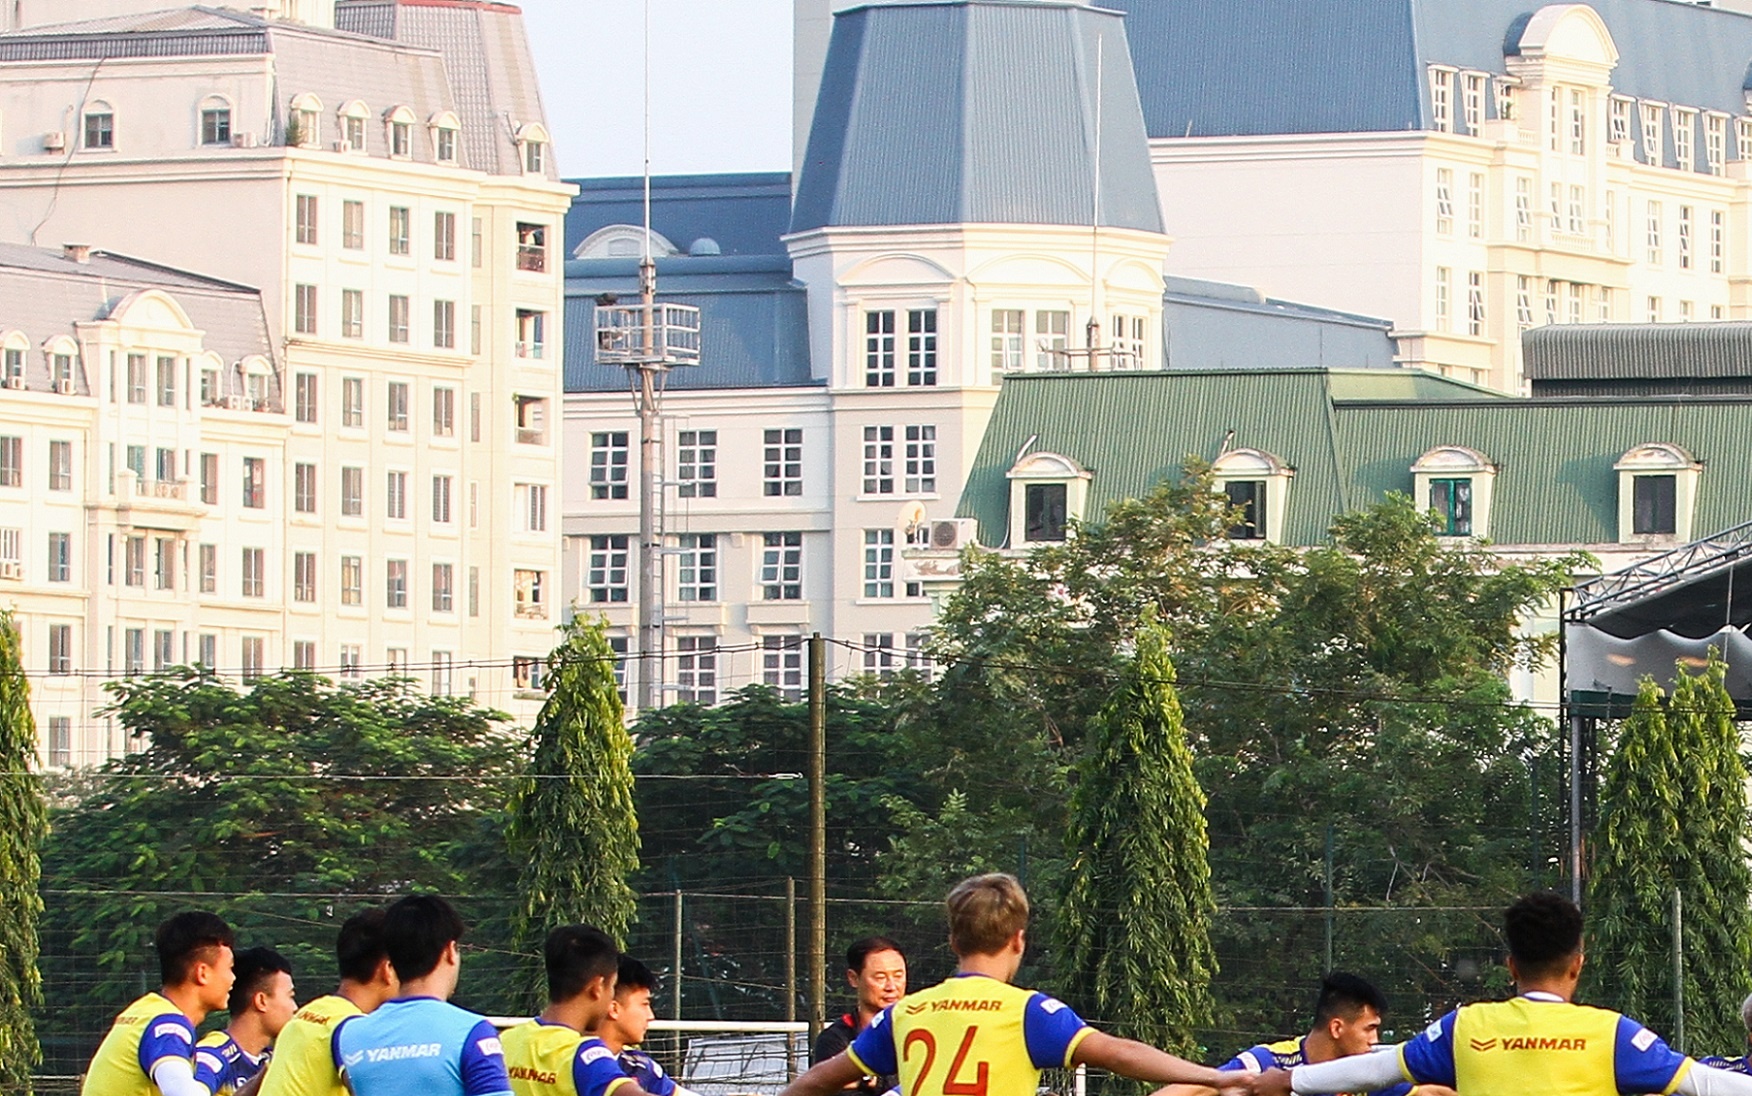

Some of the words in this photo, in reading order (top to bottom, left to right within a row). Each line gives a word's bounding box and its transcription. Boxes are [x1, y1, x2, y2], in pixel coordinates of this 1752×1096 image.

[930, 1000, 1001, 1012] YANMAR
[1502, 1038, 1587, 1050] YANMAR
[366, 1043, 441, 1063] YANMAR
